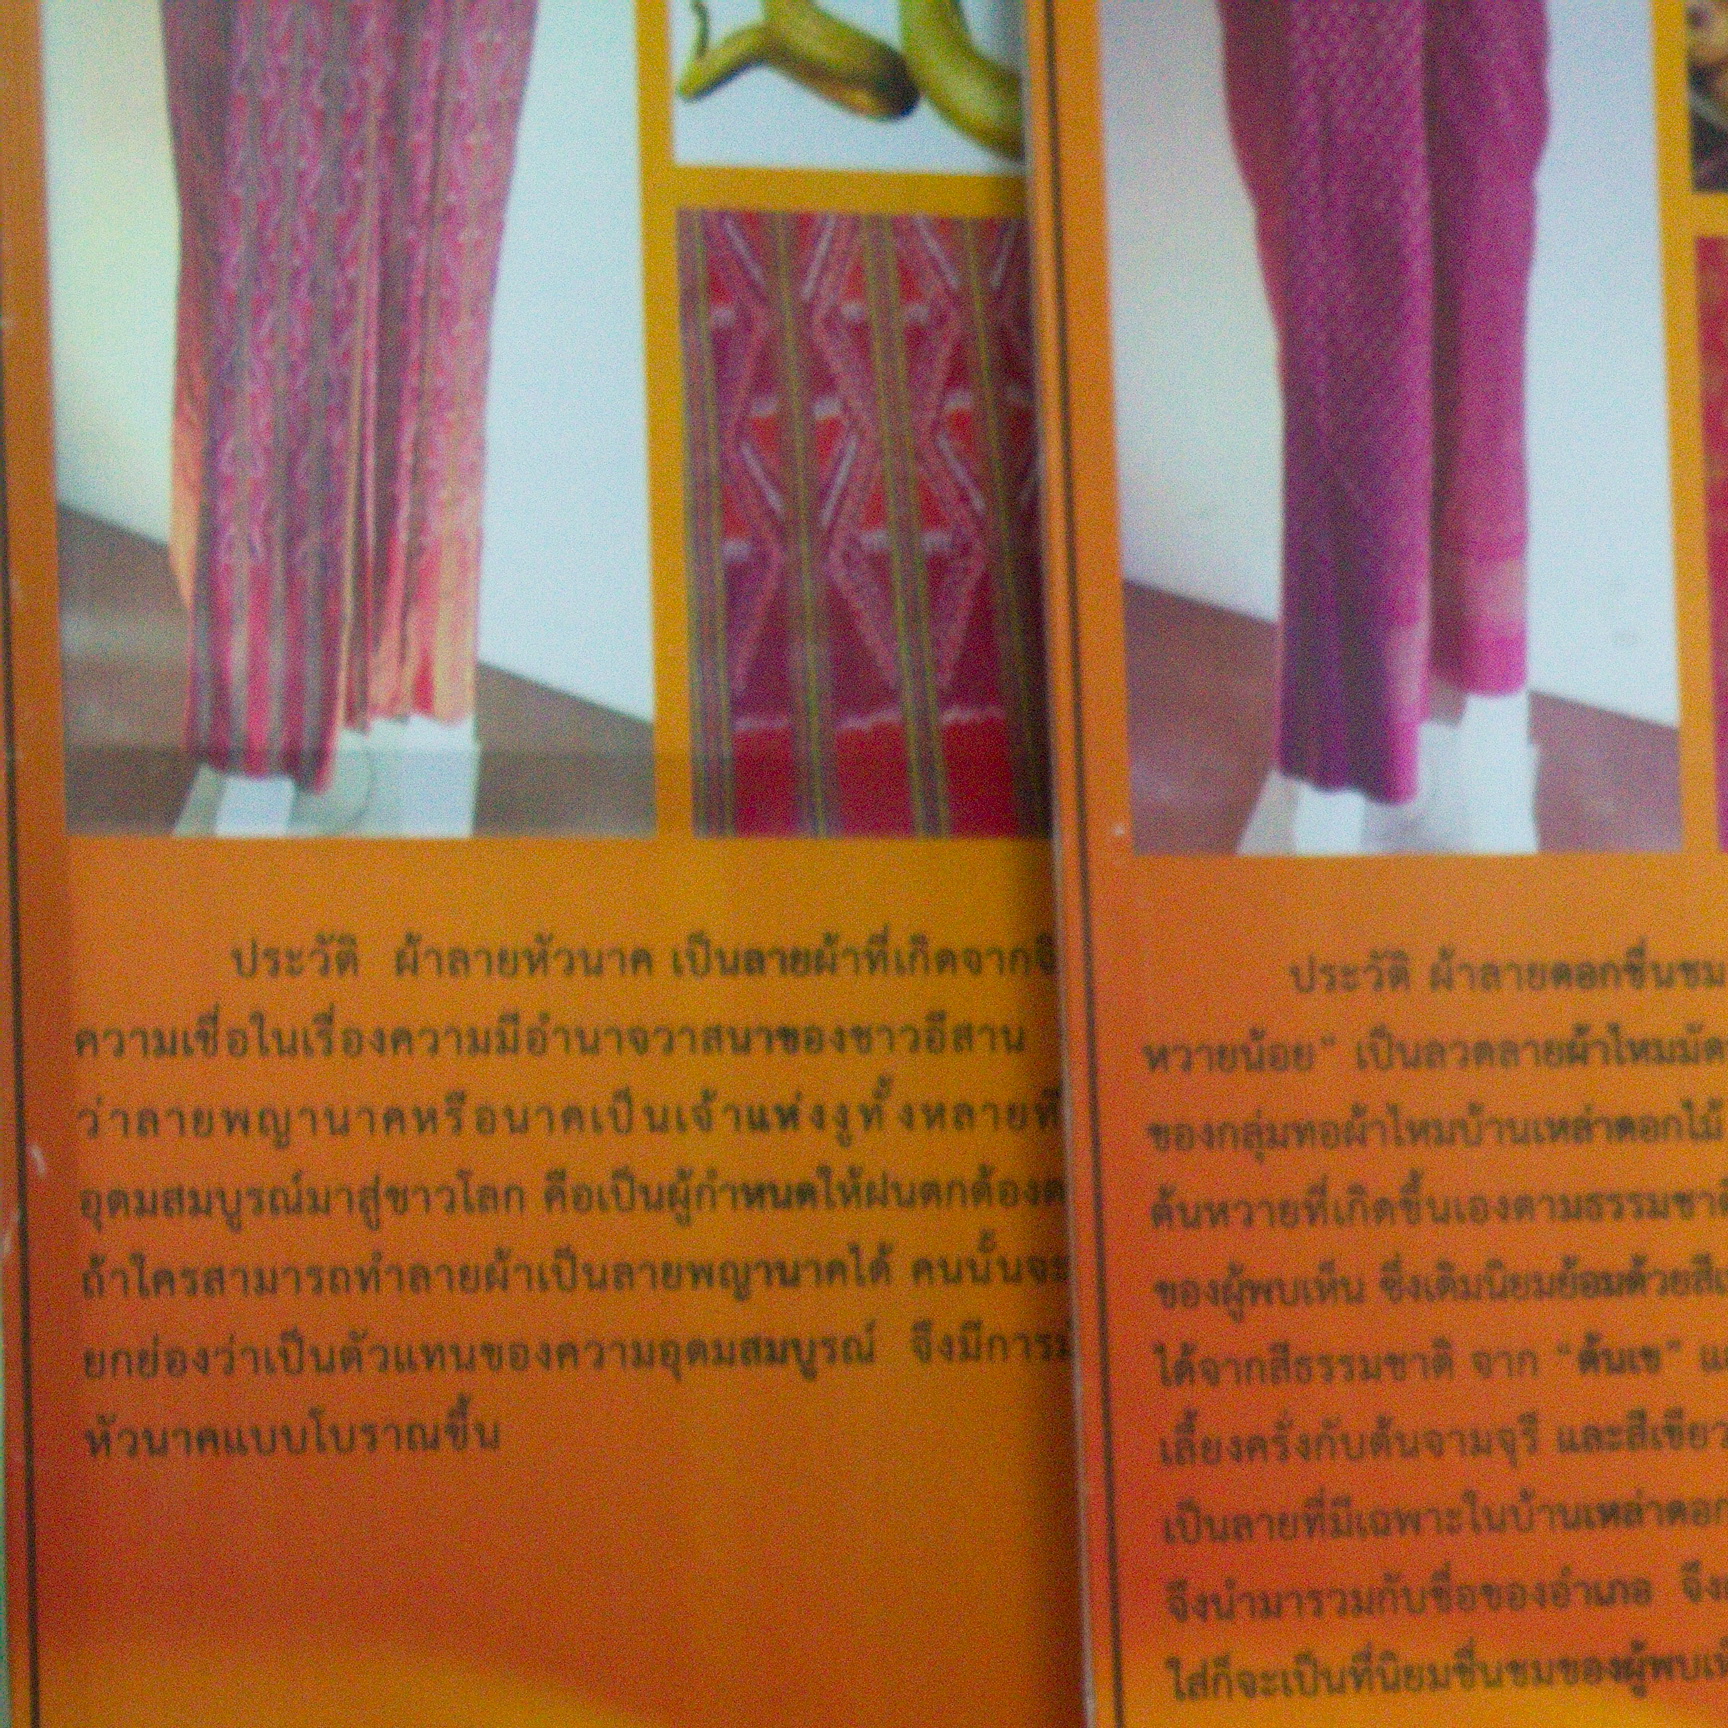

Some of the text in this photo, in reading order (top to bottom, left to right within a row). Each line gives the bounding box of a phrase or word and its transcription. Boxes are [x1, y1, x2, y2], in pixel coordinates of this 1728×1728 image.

[229, 931, 361, 980] ประวัติ
[395, 930, 655, 980] ผ้าลายหัวนาค
[1290, 948, 1411, 994] ประวัติ
[1470, 1345, 1539, 1383] จาก
